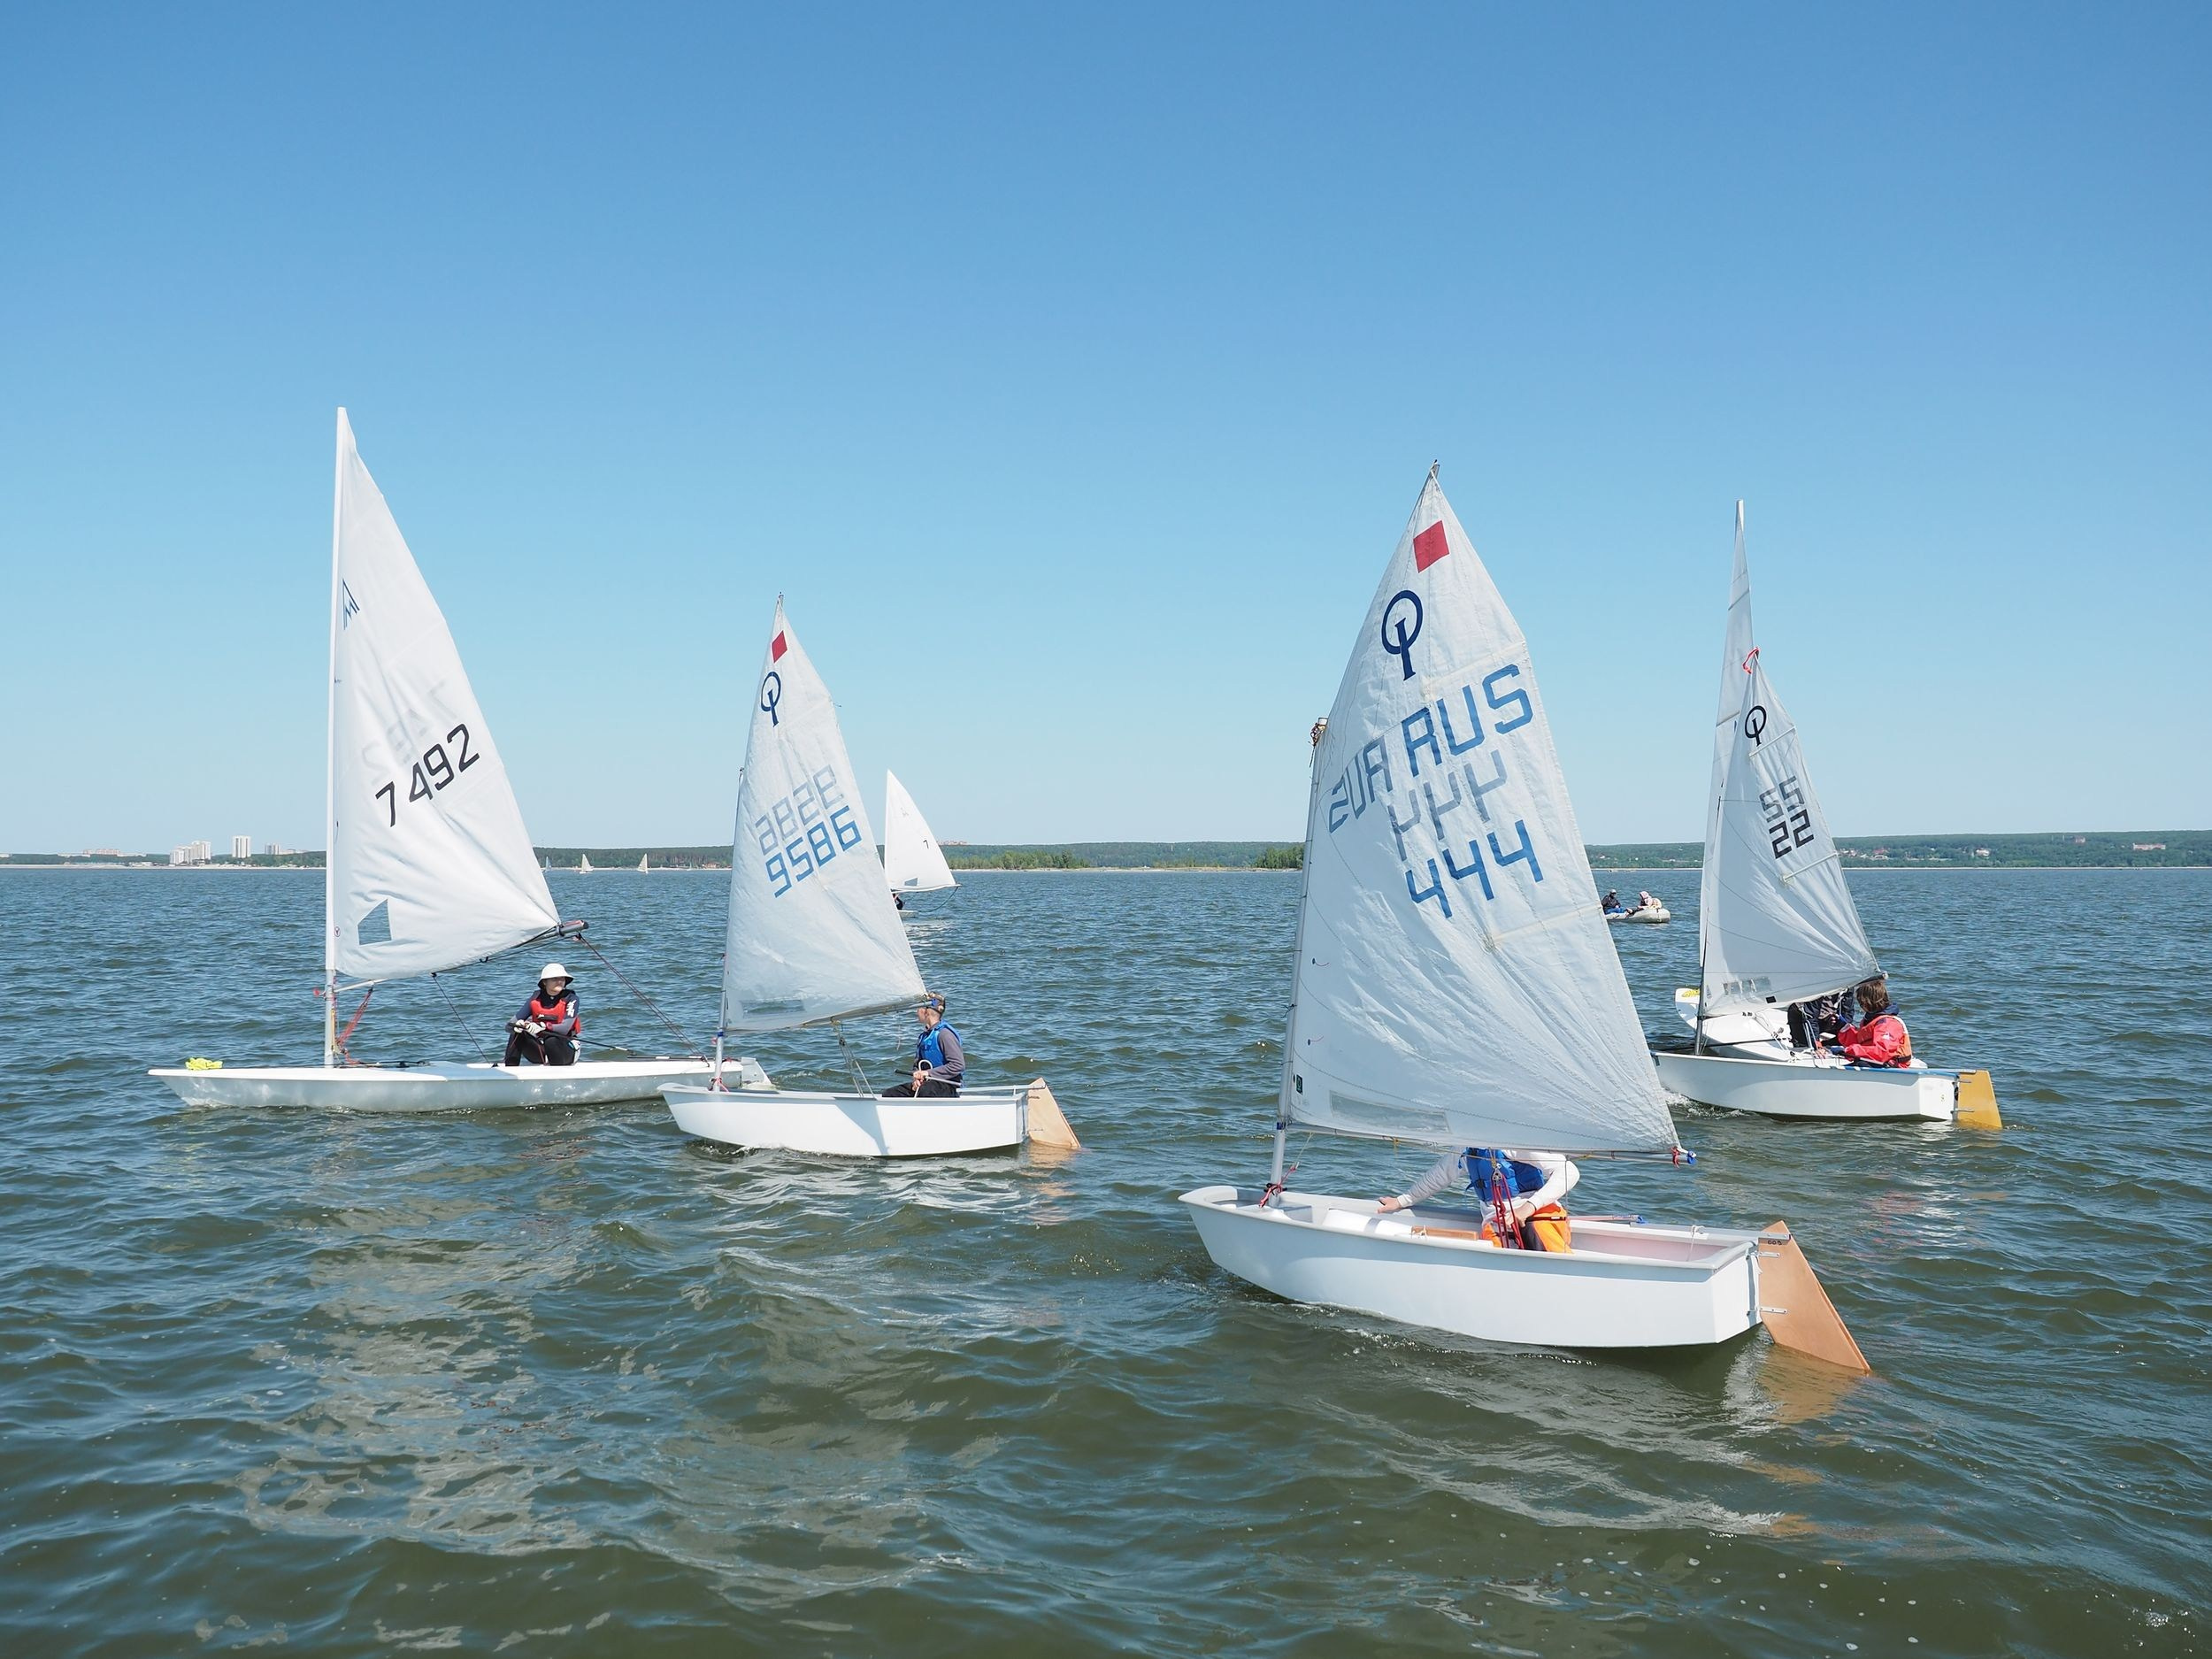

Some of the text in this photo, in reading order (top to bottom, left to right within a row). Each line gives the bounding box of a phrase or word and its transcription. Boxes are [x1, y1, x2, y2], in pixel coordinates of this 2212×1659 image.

[1402, 664, 1533, 777] RUS
[375, 724, 480, 827] 7492
[765, 805, 863, 898] 9586
[1405, 819, 1543, 919] 444
[1769, 809, 1815, 859] 22
